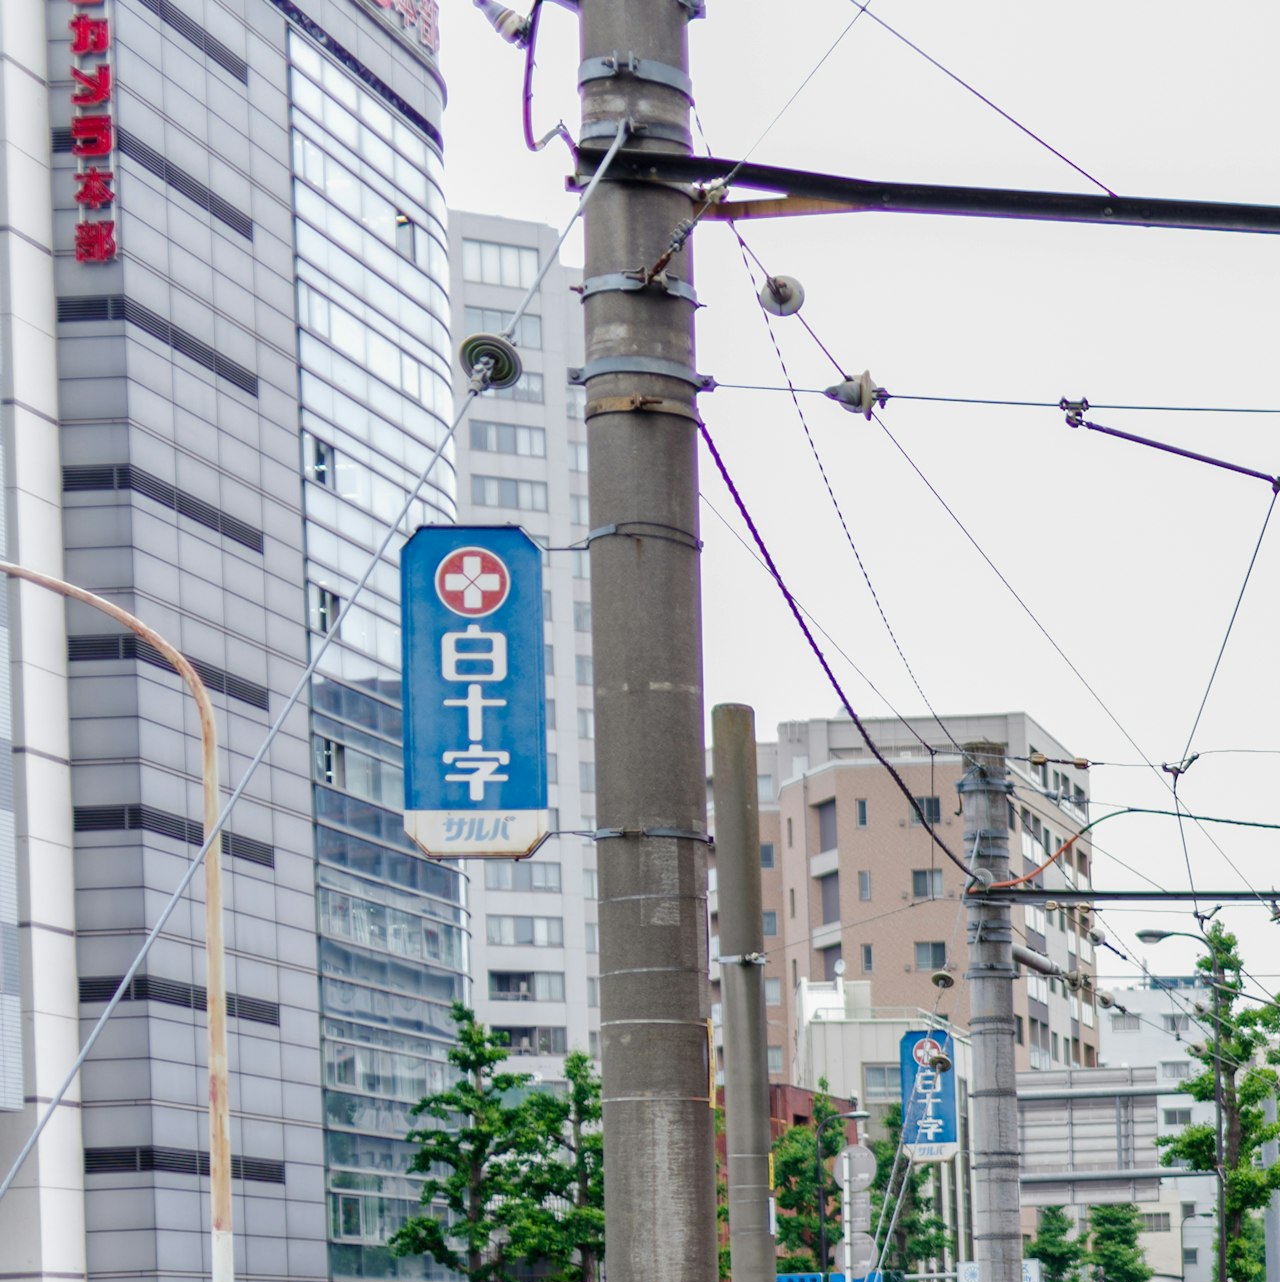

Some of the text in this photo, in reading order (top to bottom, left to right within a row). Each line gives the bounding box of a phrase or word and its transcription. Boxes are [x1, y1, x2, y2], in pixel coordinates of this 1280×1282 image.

[68, 0, 118, 264] カメラ本部
[441, 624, 510, 801] 白十字
[442, 815, 516, 842] サルバ
[916, 1069, 944, 1141] 白十字
